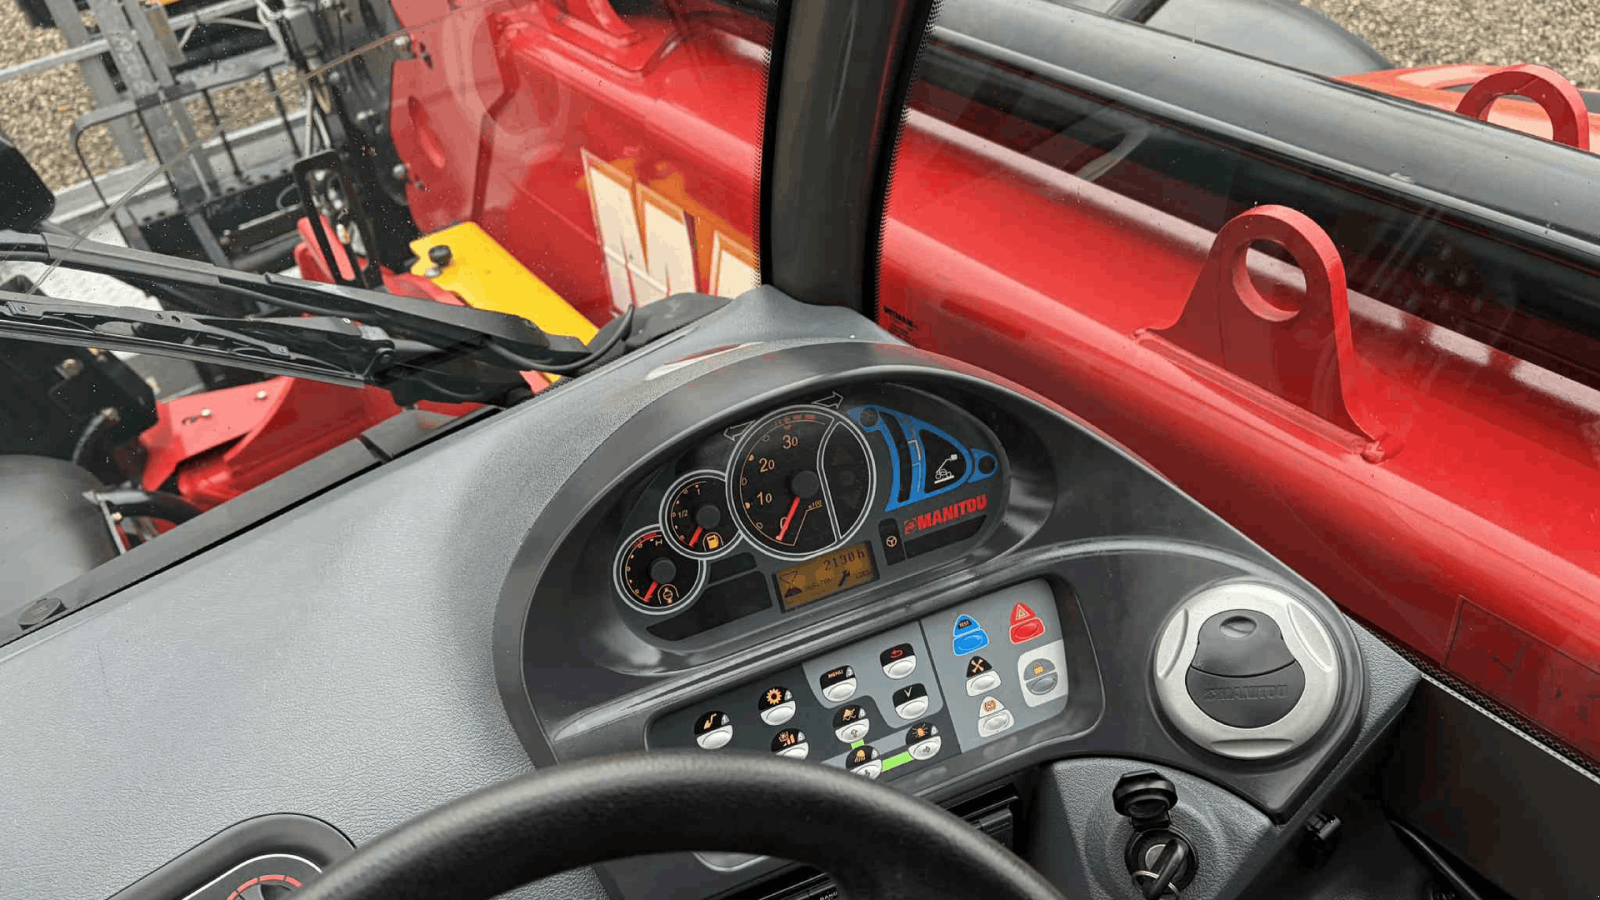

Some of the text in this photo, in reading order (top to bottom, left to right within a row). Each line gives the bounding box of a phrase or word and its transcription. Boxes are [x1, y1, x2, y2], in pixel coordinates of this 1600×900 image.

[782, 434, 799, 449] 30
[758, 457, 776, 472] 20
[756, 491, 773, 505] 10
[676, 509, 689, 519] 1/2
[916, 493, 988, 531] MANITOU
[903, 686, 913, 698] V
